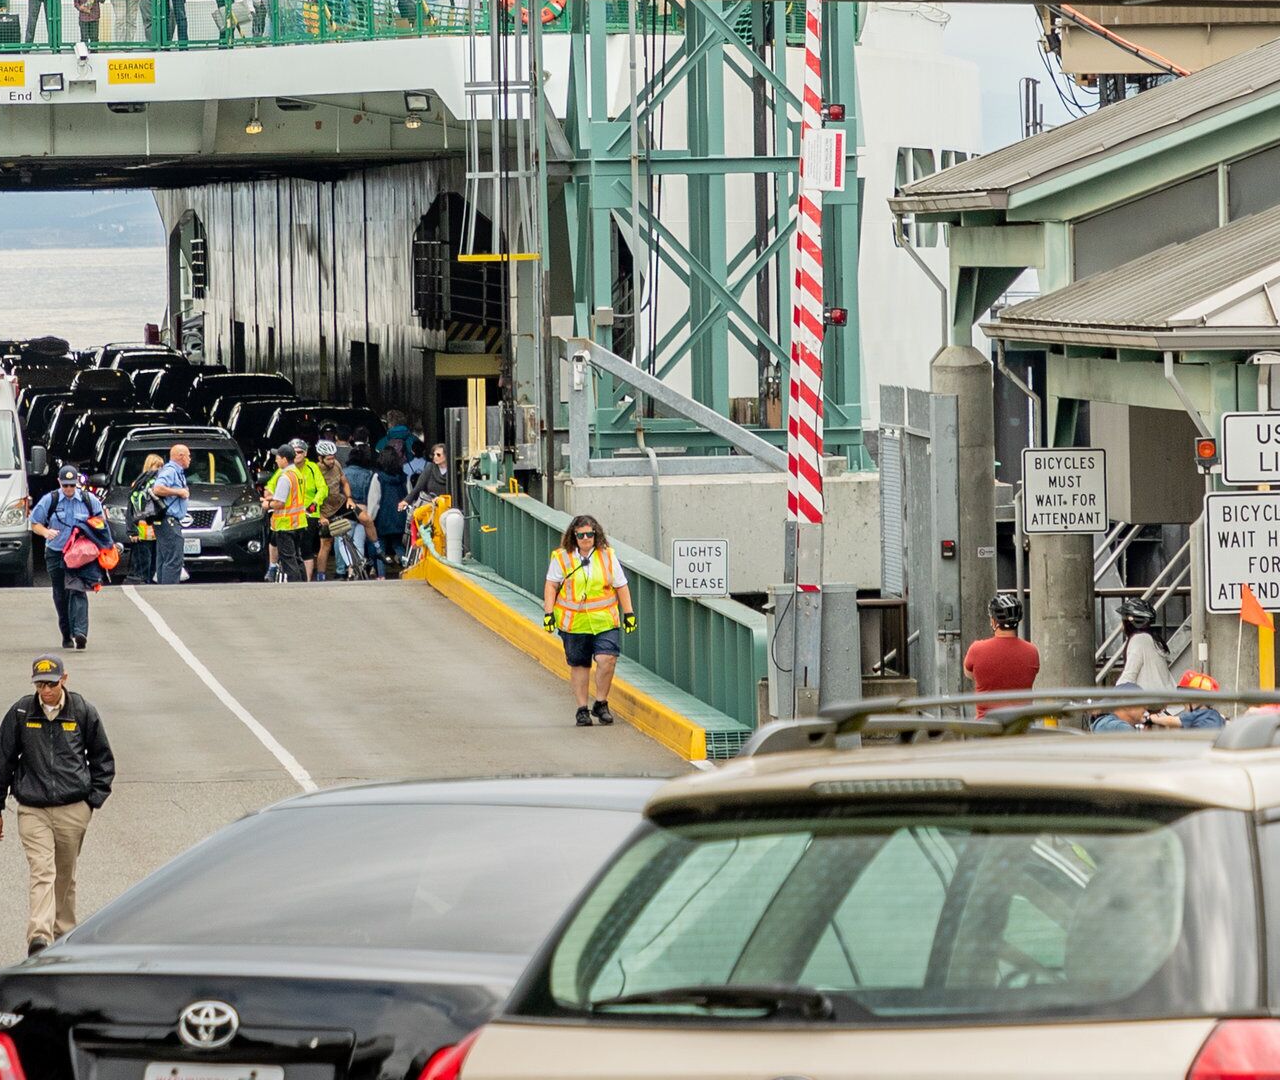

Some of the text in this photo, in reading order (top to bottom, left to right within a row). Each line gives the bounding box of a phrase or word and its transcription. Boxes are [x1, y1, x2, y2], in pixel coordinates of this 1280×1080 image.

[108, 62, 155, 71] CLEARANCE
[4, 75, 17, 83] 4in.
[116, 72, 147, 80] 15ft. 4in.
[9, 91, 32, 101] End
[1034, 457, 1095, 470] BICYCLES
[1048, 475, 1082, 488] MUST
[1035, 493, 1096, 507] WAIT FOR
[1031, 512, 1101, 526] ATTENDANT
[1218, 530, 1256, 548] WAIT
[678, 546, 722, 557] LIGHTS
[688, 561, 712, 573] OUT
[1248, 556, 1280, 574] FOR
[676, 577, 724, 589] PLEASE
